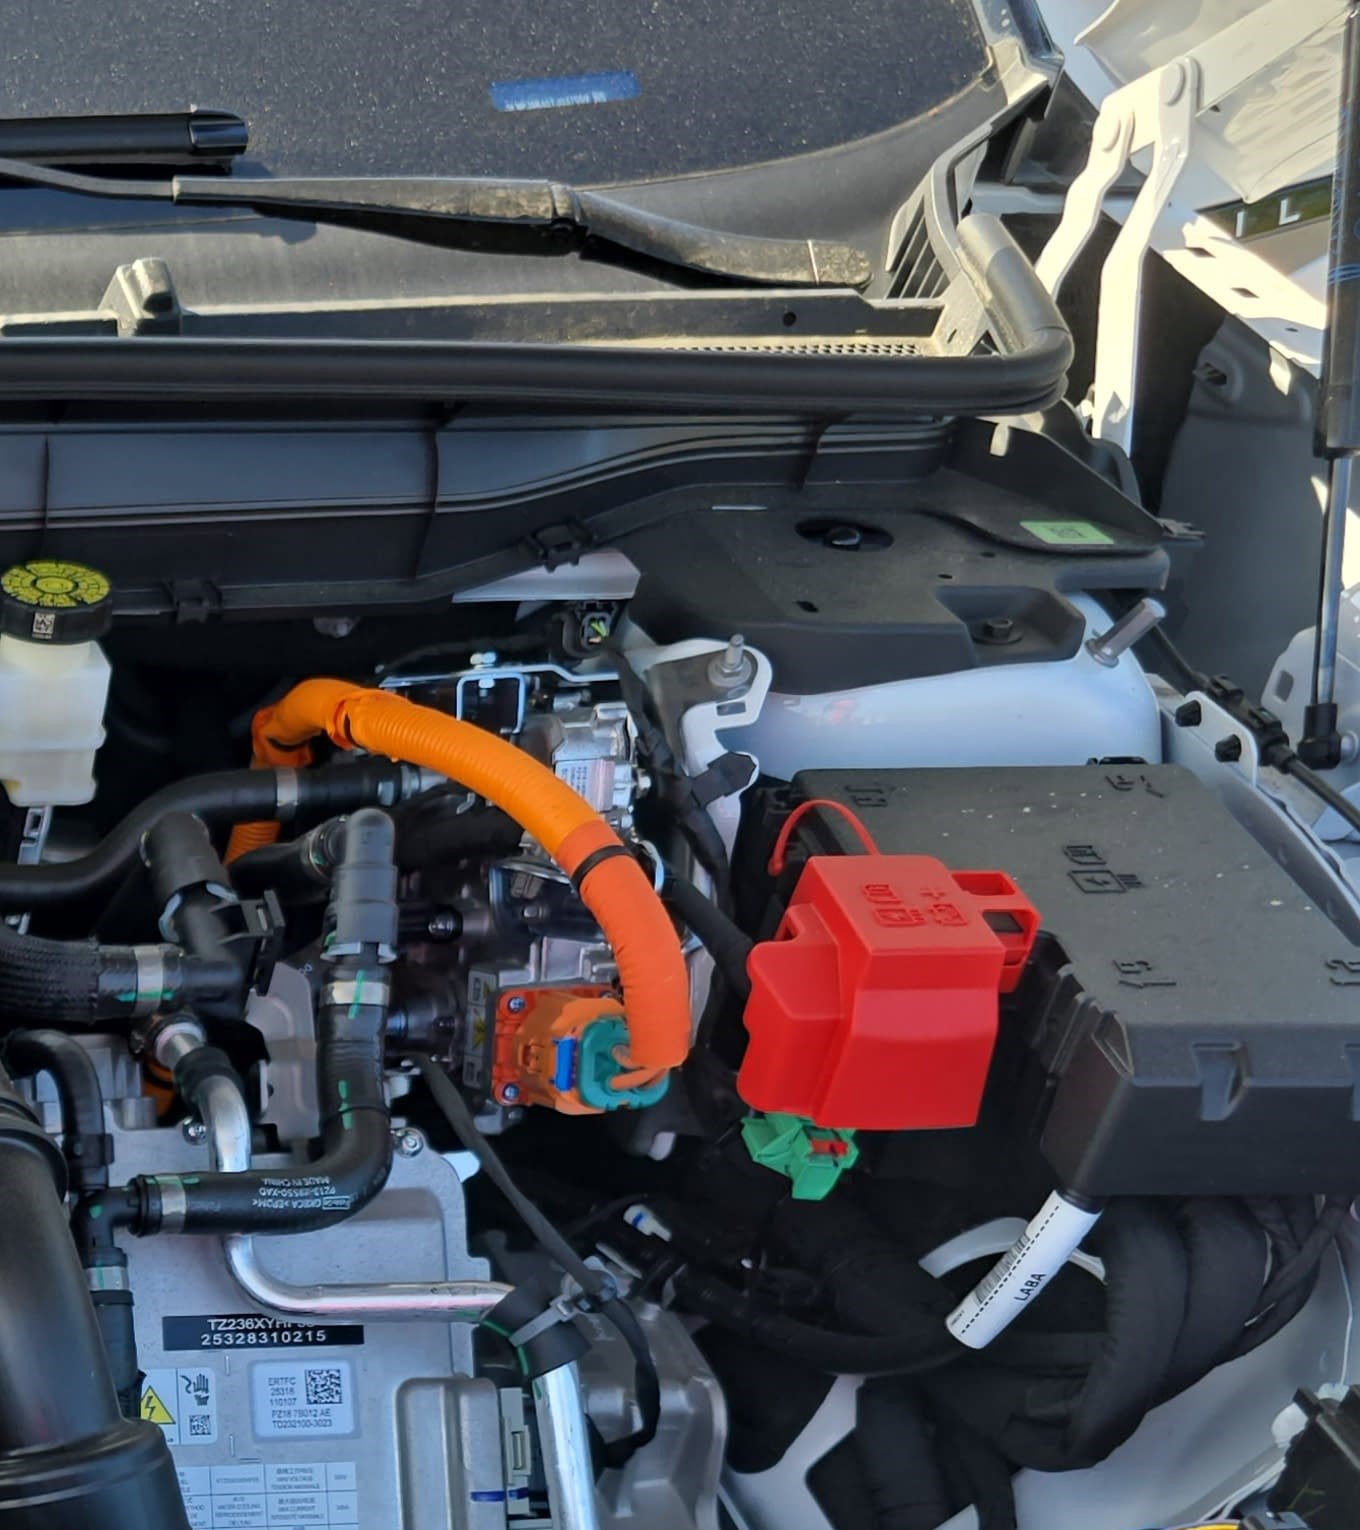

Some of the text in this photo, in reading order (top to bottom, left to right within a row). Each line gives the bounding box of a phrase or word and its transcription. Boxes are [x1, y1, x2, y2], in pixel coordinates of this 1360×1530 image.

[1014, 1272, 1047, 1302] LABA
[208, 1317, 315, 1331] TZ236XYH
[201, 1330, 327, 1346] 25328310215
